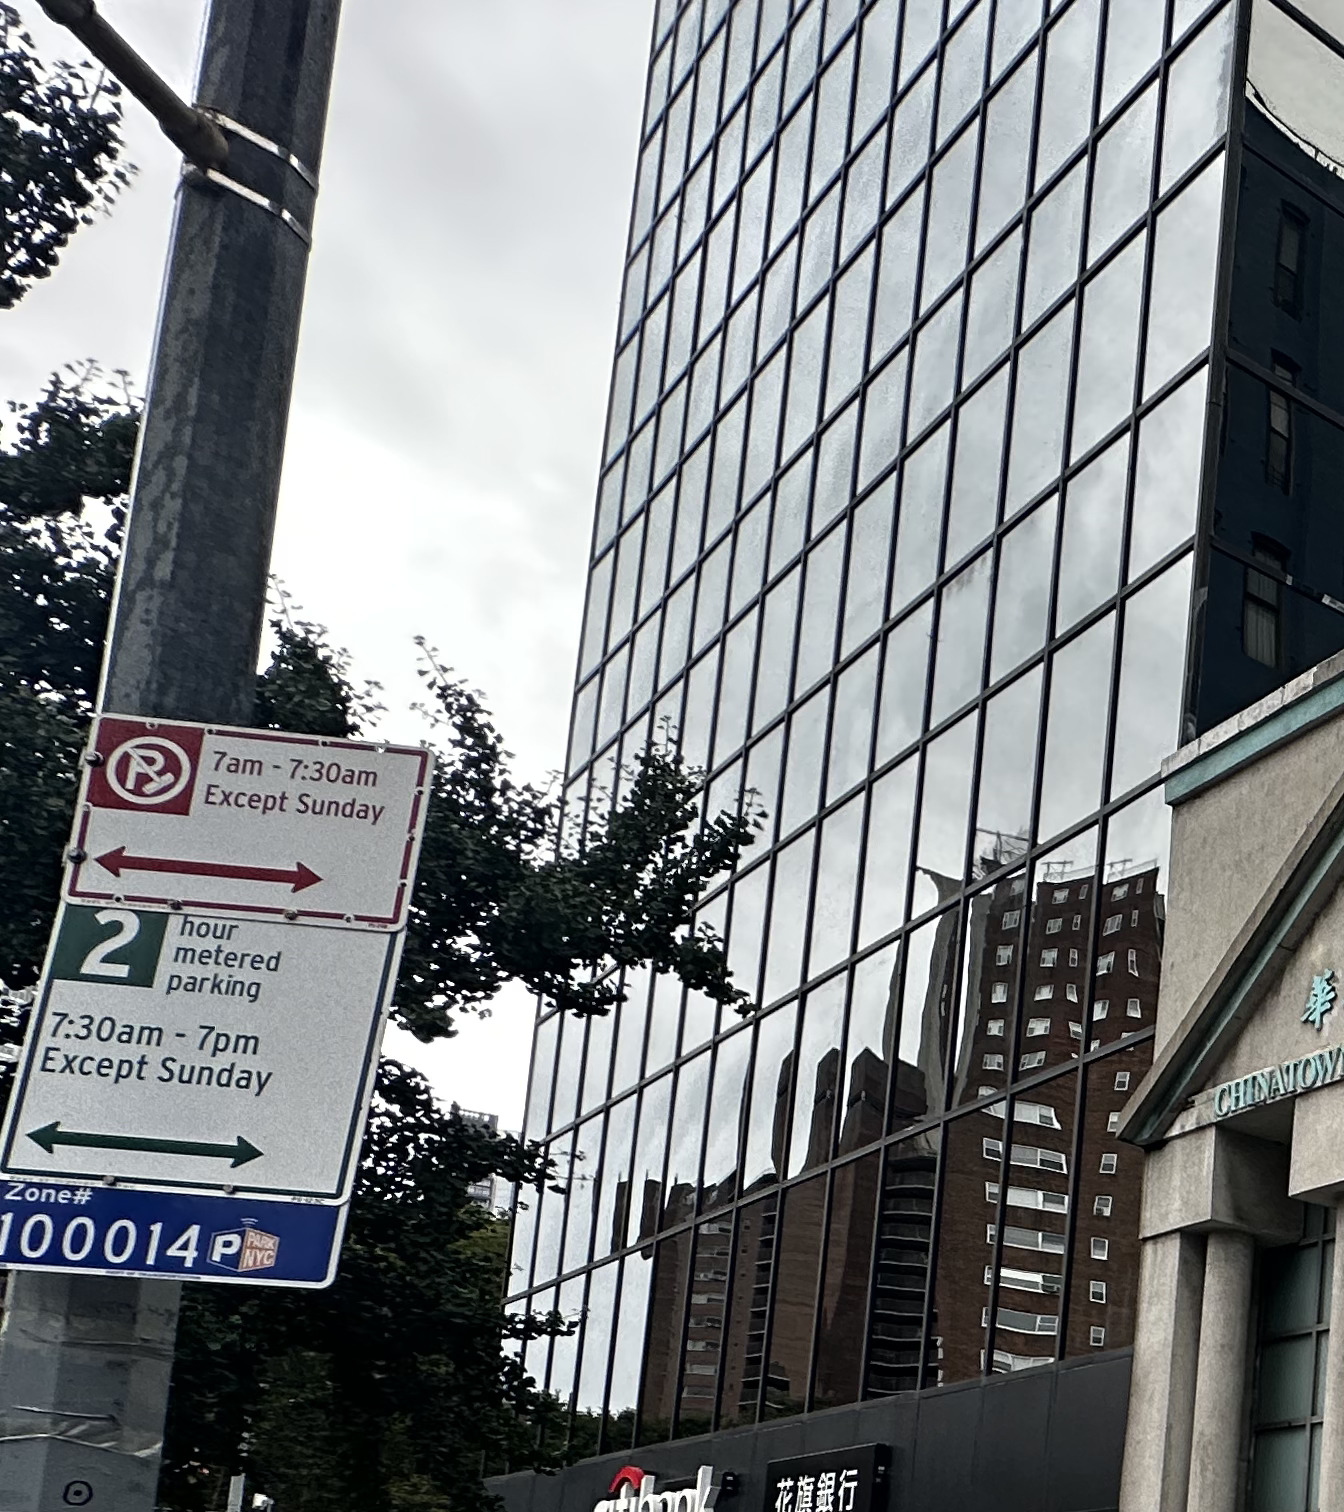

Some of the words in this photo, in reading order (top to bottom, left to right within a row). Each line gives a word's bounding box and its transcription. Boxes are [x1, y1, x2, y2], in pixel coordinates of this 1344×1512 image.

[213, 751, 264, 776] 7am
[290, 758, 378, 787] 7:30am
[204, 784, 288, 814] Except
[296, 793, 385, 825] Sunday
[80, 908, 141, 978] 2
[180, 914, 239, 941] hour
[173, 945, 282, 972] metered
[166, 974, 262, 1003] parking
[51, 1012, 164, 1047] 7:30am
[198, 1025, 260, 1057] 7pm
[40, 1047, 149, 1084] Except
[157, 1057, 273, 1097] Sunday
[4, 1182, 94, 1205] Zone#
[0, 1212, 201, 1268] 100014
[242, 1248, 274, 1268] NYC
[247, 1231, 275, 1249] PARK
